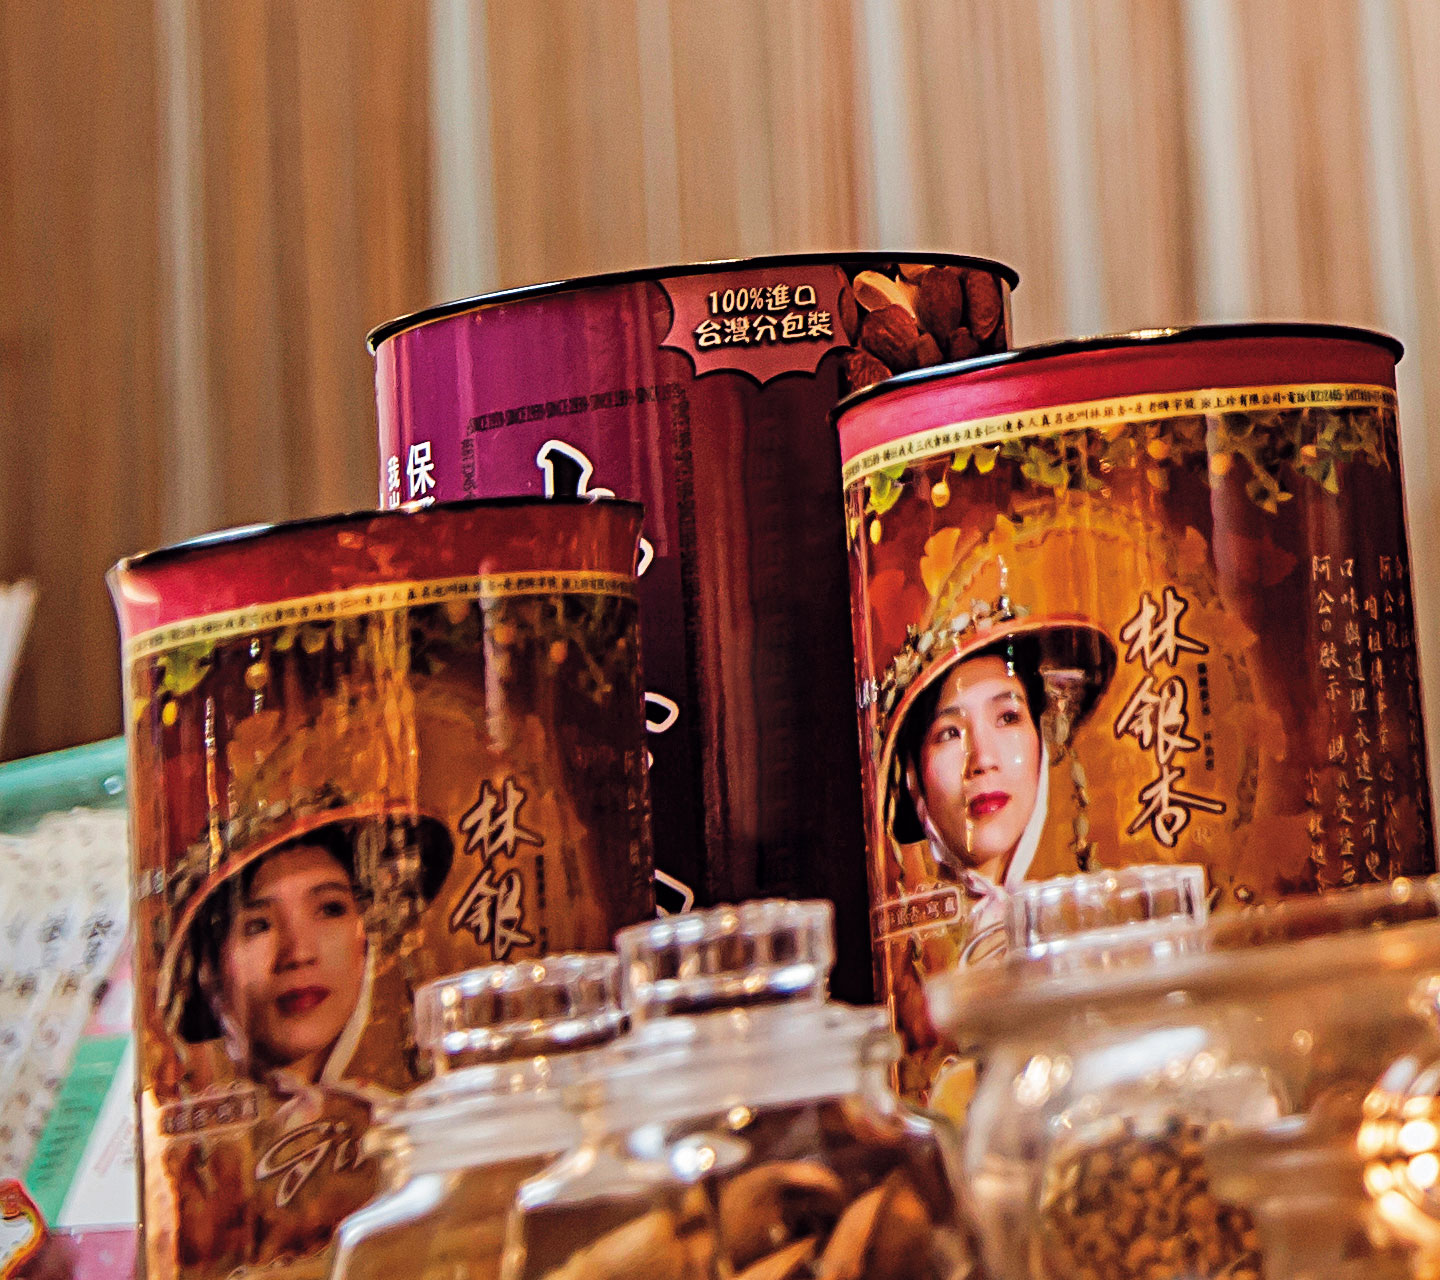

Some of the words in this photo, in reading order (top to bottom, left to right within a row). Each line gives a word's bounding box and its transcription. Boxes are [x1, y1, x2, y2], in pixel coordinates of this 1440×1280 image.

[708, 283, 817, 315] 100%進口
[695, 310, 834, 348] 台灣分包裝
[1114, 586, 1226, 848] 林銀杏
